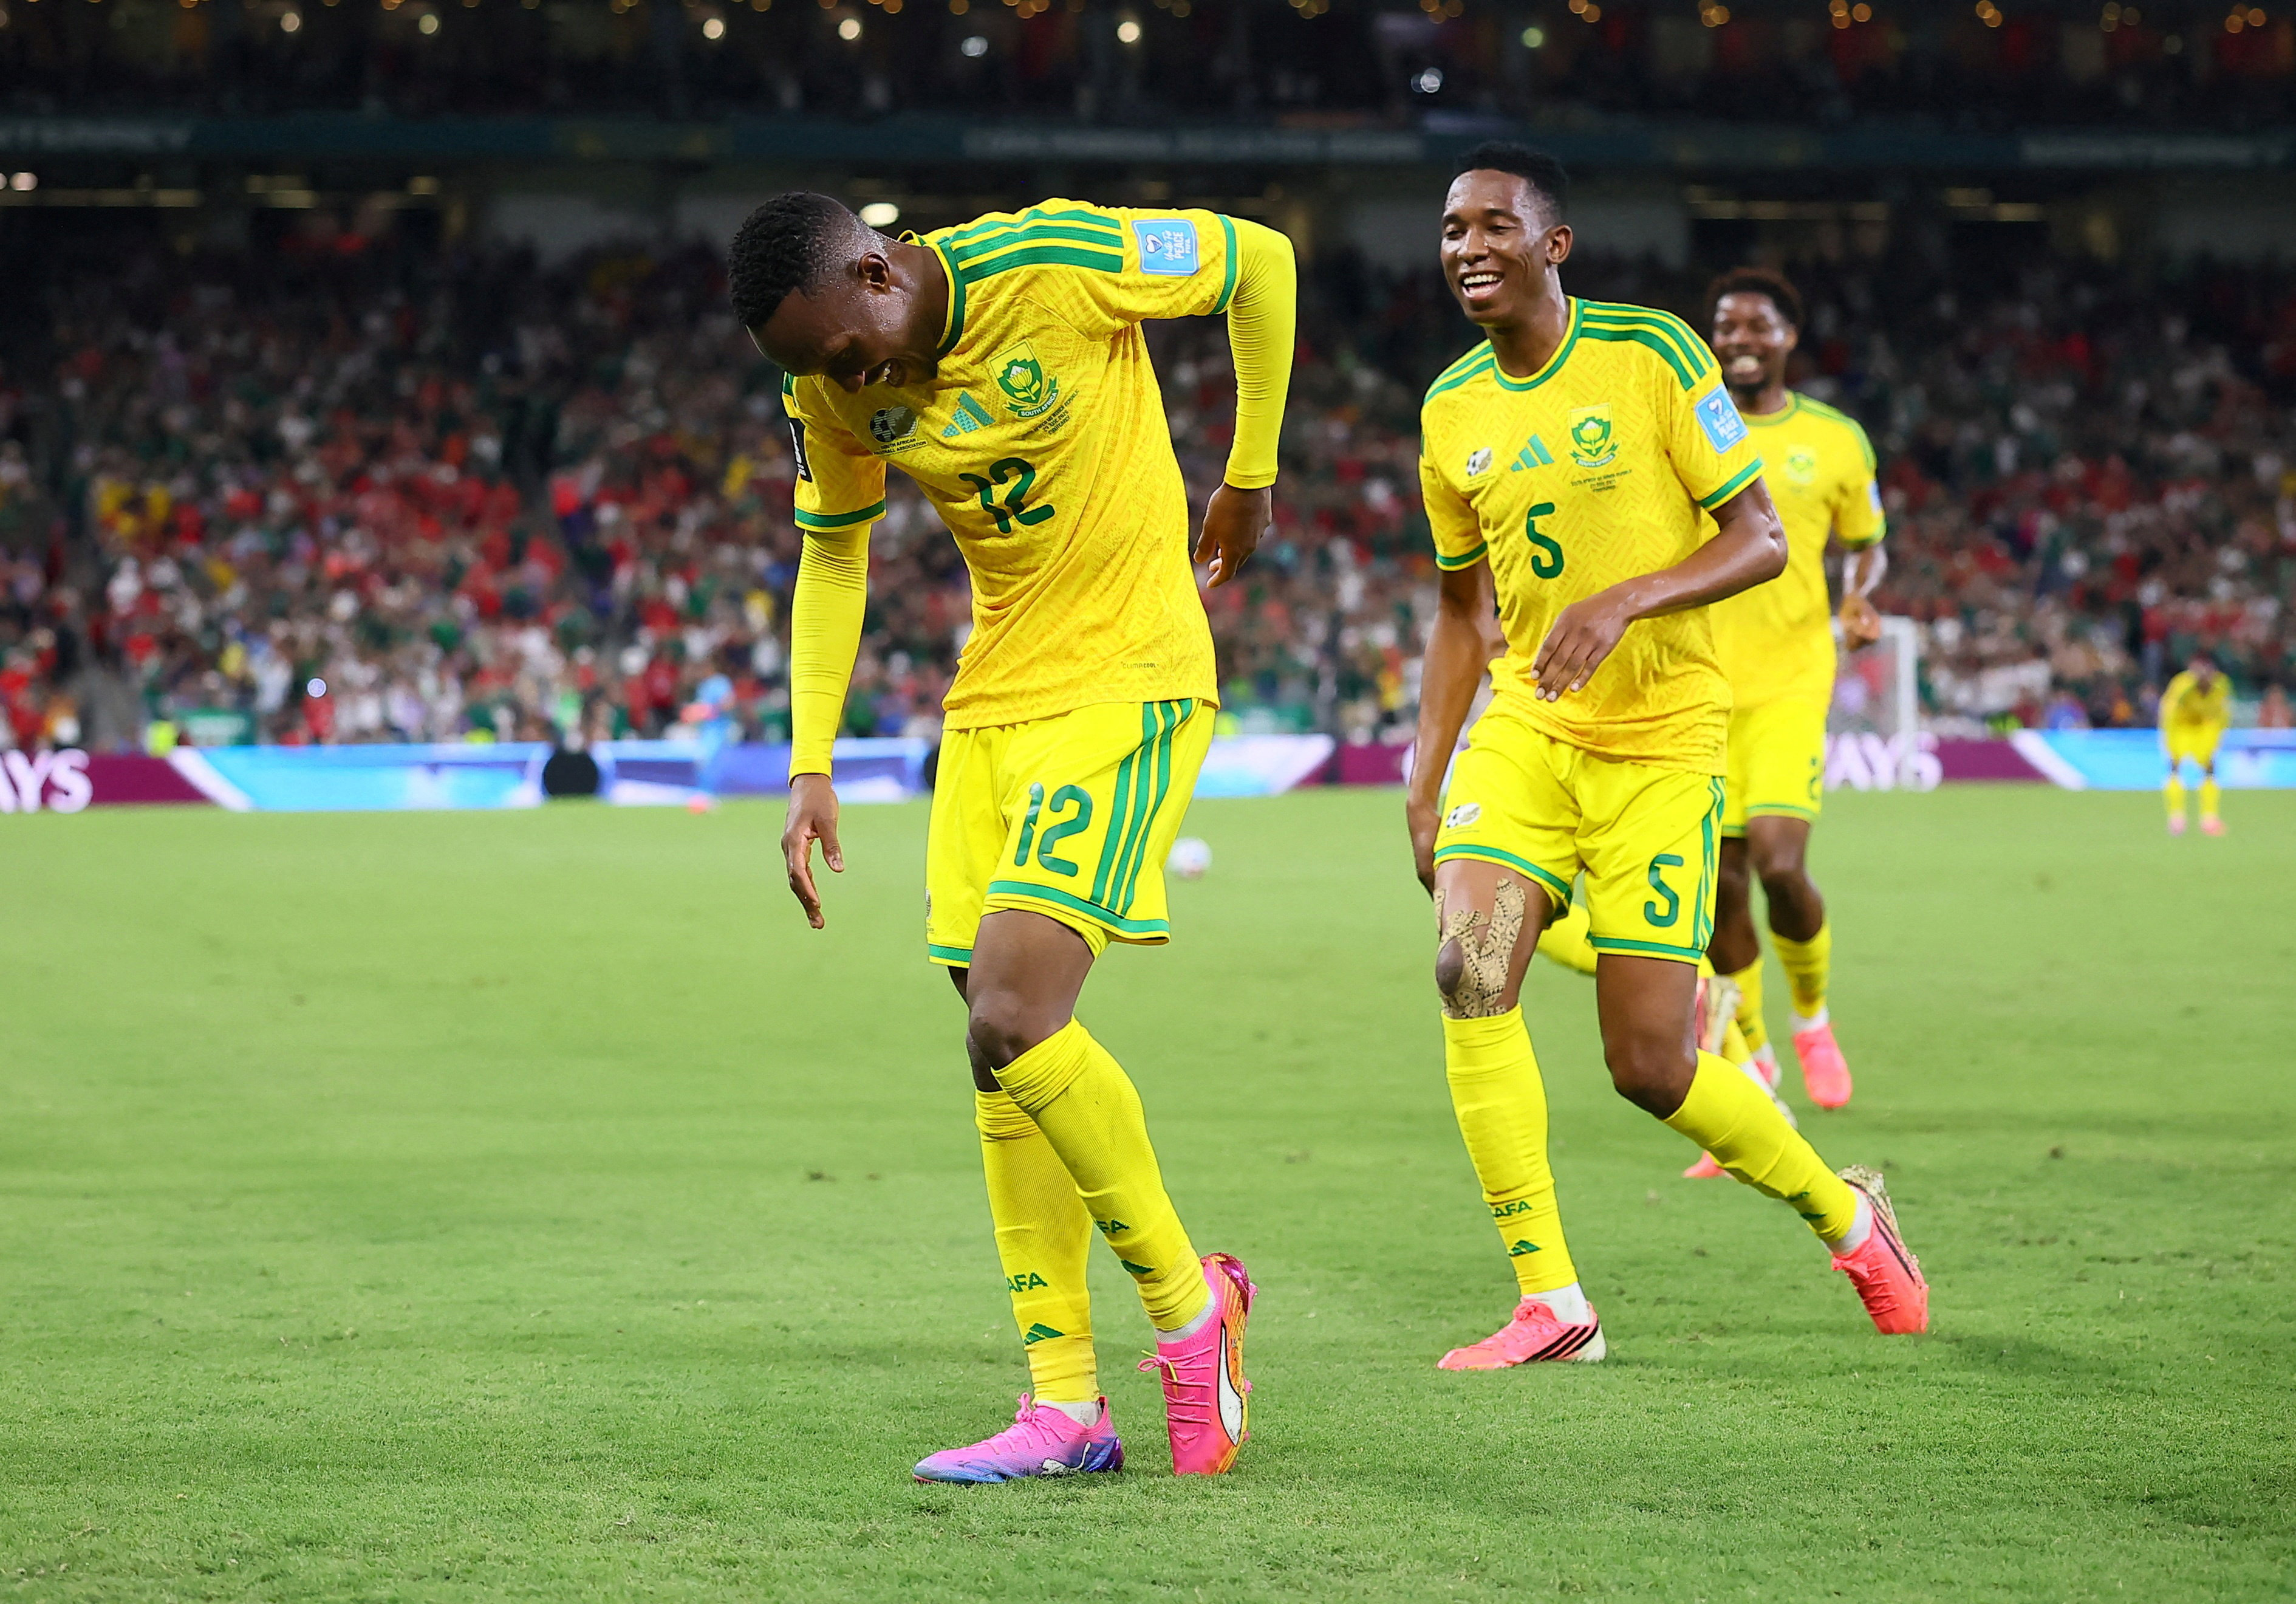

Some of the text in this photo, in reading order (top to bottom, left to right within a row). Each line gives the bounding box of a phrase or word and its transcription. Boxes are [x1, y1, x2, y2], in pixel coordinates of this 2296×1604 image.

[1173, 231, 1184, 259] PEACE
[1042, 392, 1057, 411] AFRICA
[897, 440, 927, 451] ASSOCIATION
[958, 458, 1055, 533] 12
[1526, 502, 1564, 578] 5
[1823, 731, 1943, 792] AYS
[1014, 783, 1093, 877] 12
[1644, 854, 1684, 927] 5
